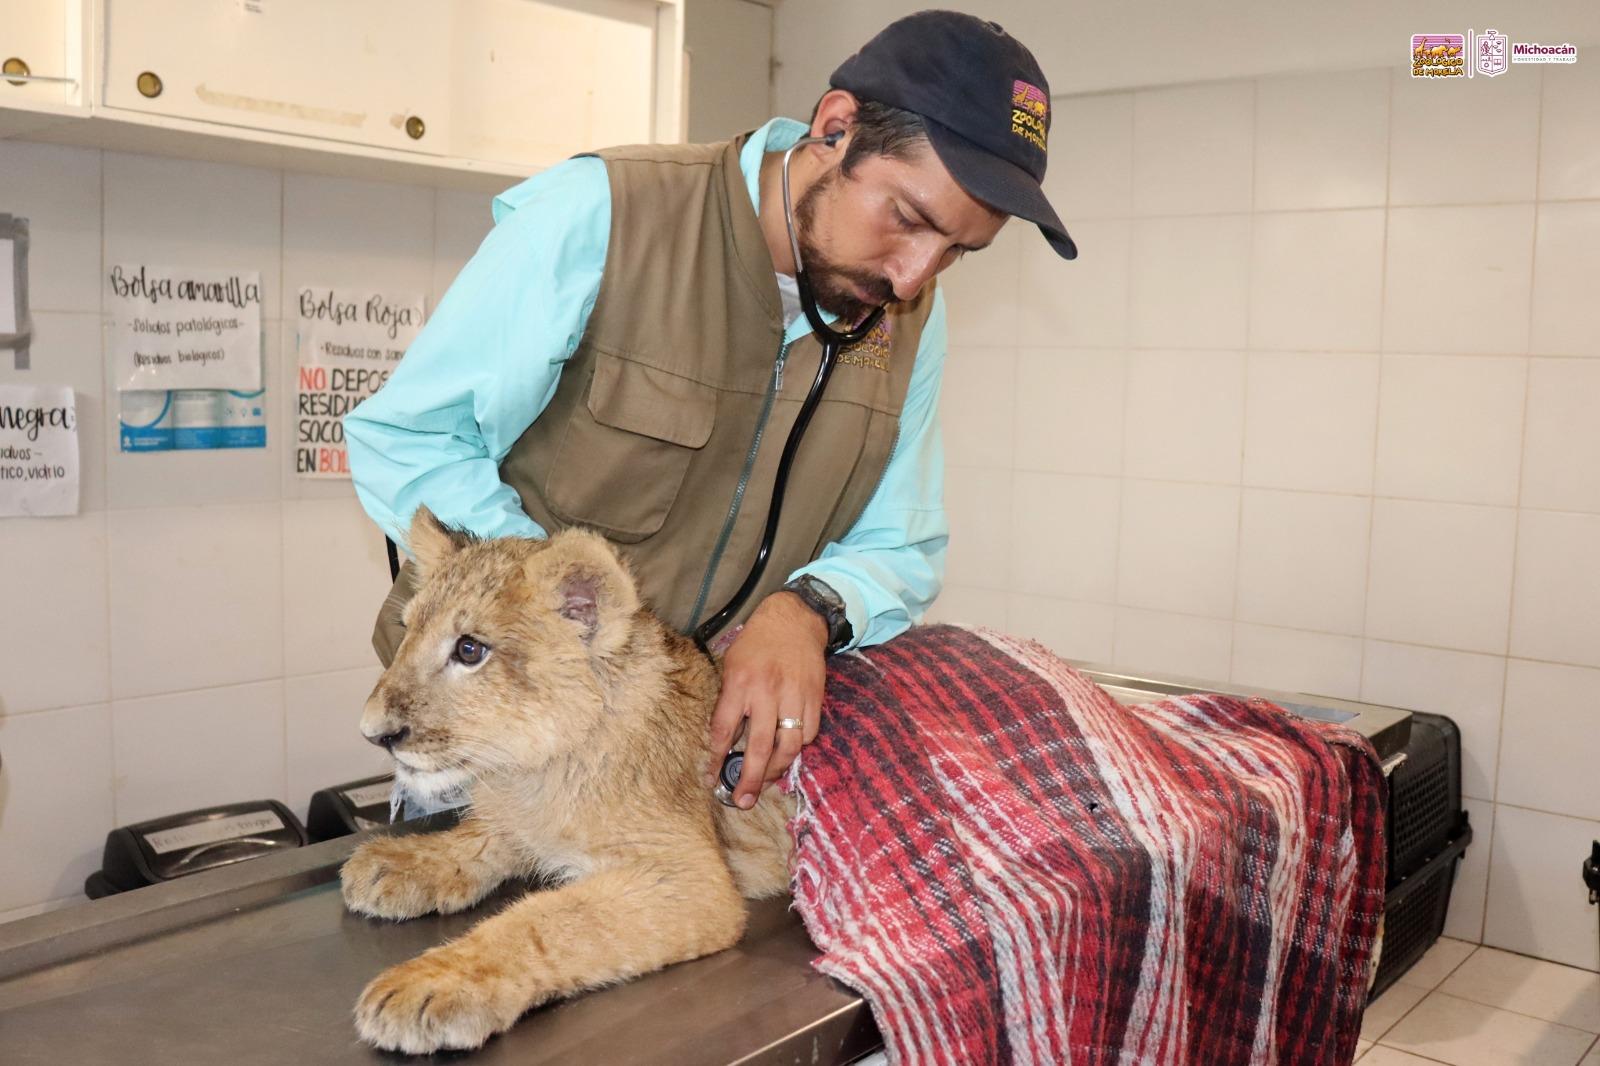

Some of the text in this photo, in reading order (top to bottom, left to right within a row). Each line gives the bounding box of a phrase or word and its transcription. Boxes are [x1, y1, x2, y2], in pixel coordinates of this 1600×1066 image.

[110, 265, 173, 304] Bolsa
[300, 289, 412, 340] Bolsa Roja
[300, 367, 327, 391] NO
[297, 448, 317, 473] EN
